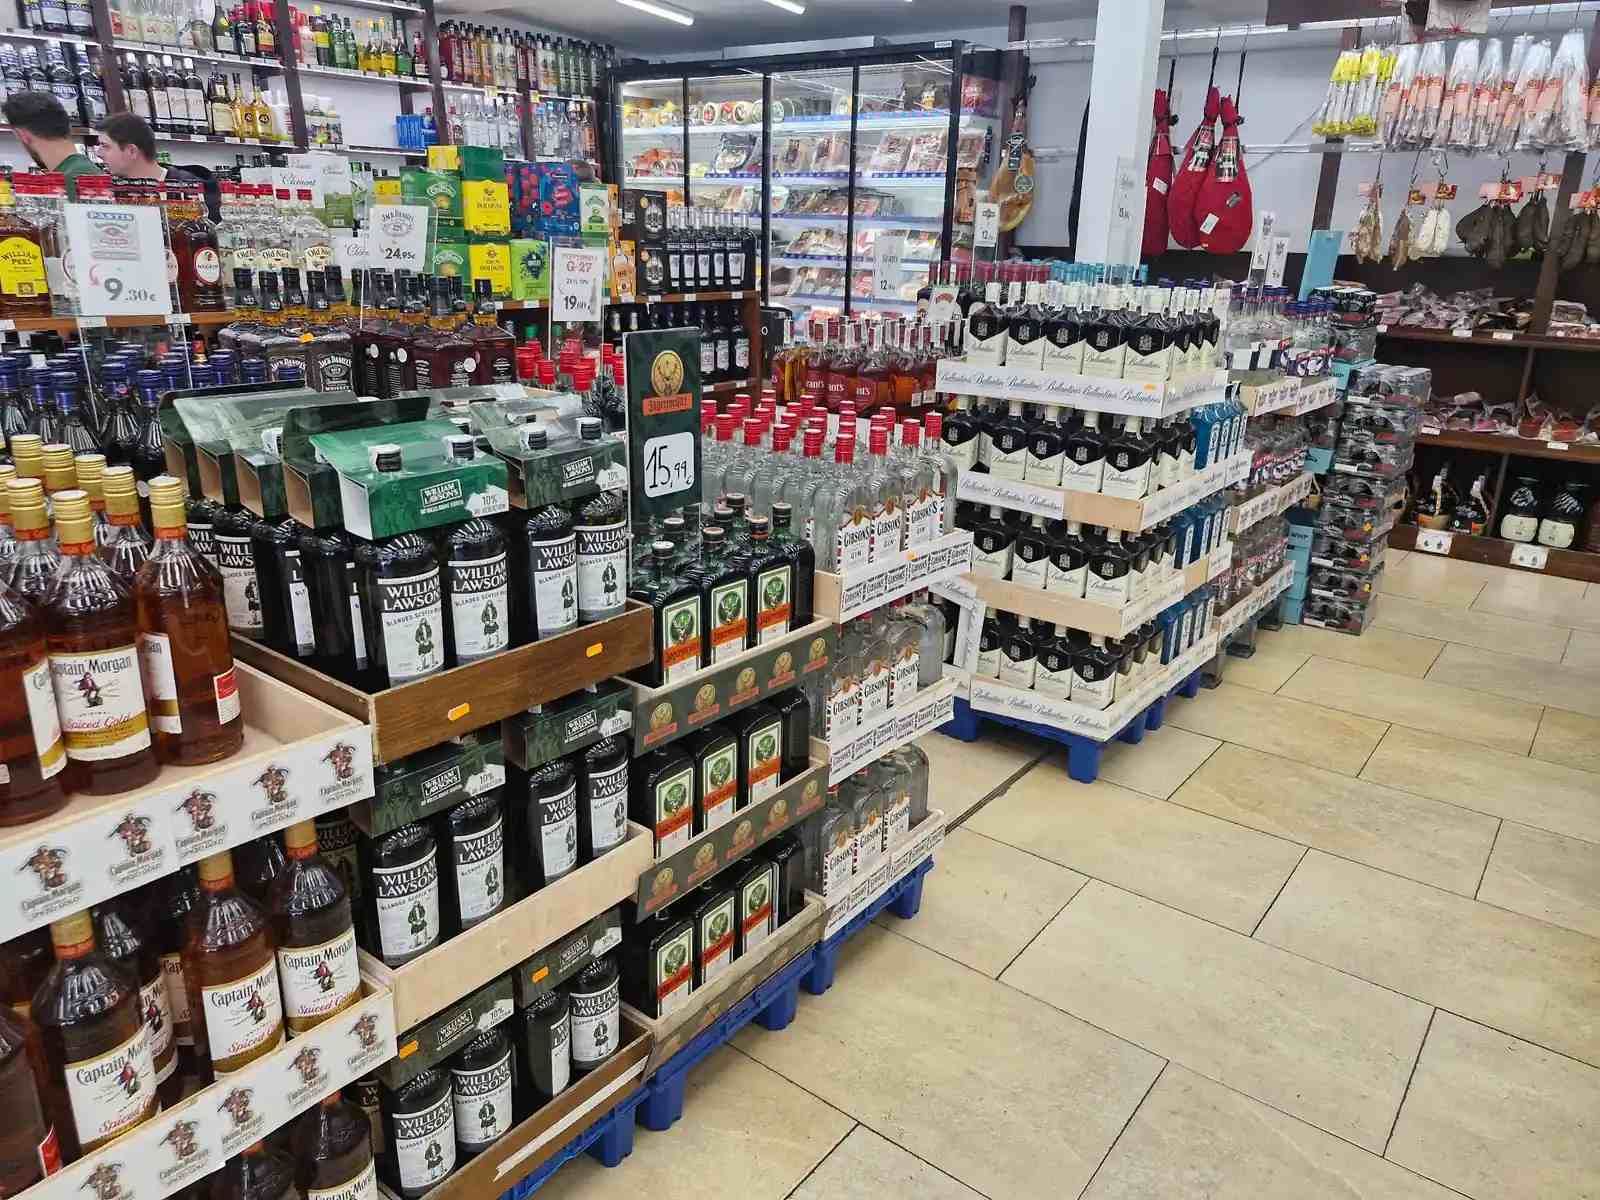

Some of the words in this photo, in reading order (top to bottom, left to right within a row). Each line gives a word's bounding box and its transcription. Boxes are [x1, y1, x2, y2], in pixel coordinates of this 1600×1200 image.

[541, 540, 576, 558] WILLI
[538, 553, 576, 570] LAWSO
[88, 656, 131, 675] Morgan
[282, 952, 321, 970] Captain
[210, 990, 254, 1008] Captain
[76, 1053, 126, 1086] Captain
[457, 1060, 510, 1085] WILLIAM
